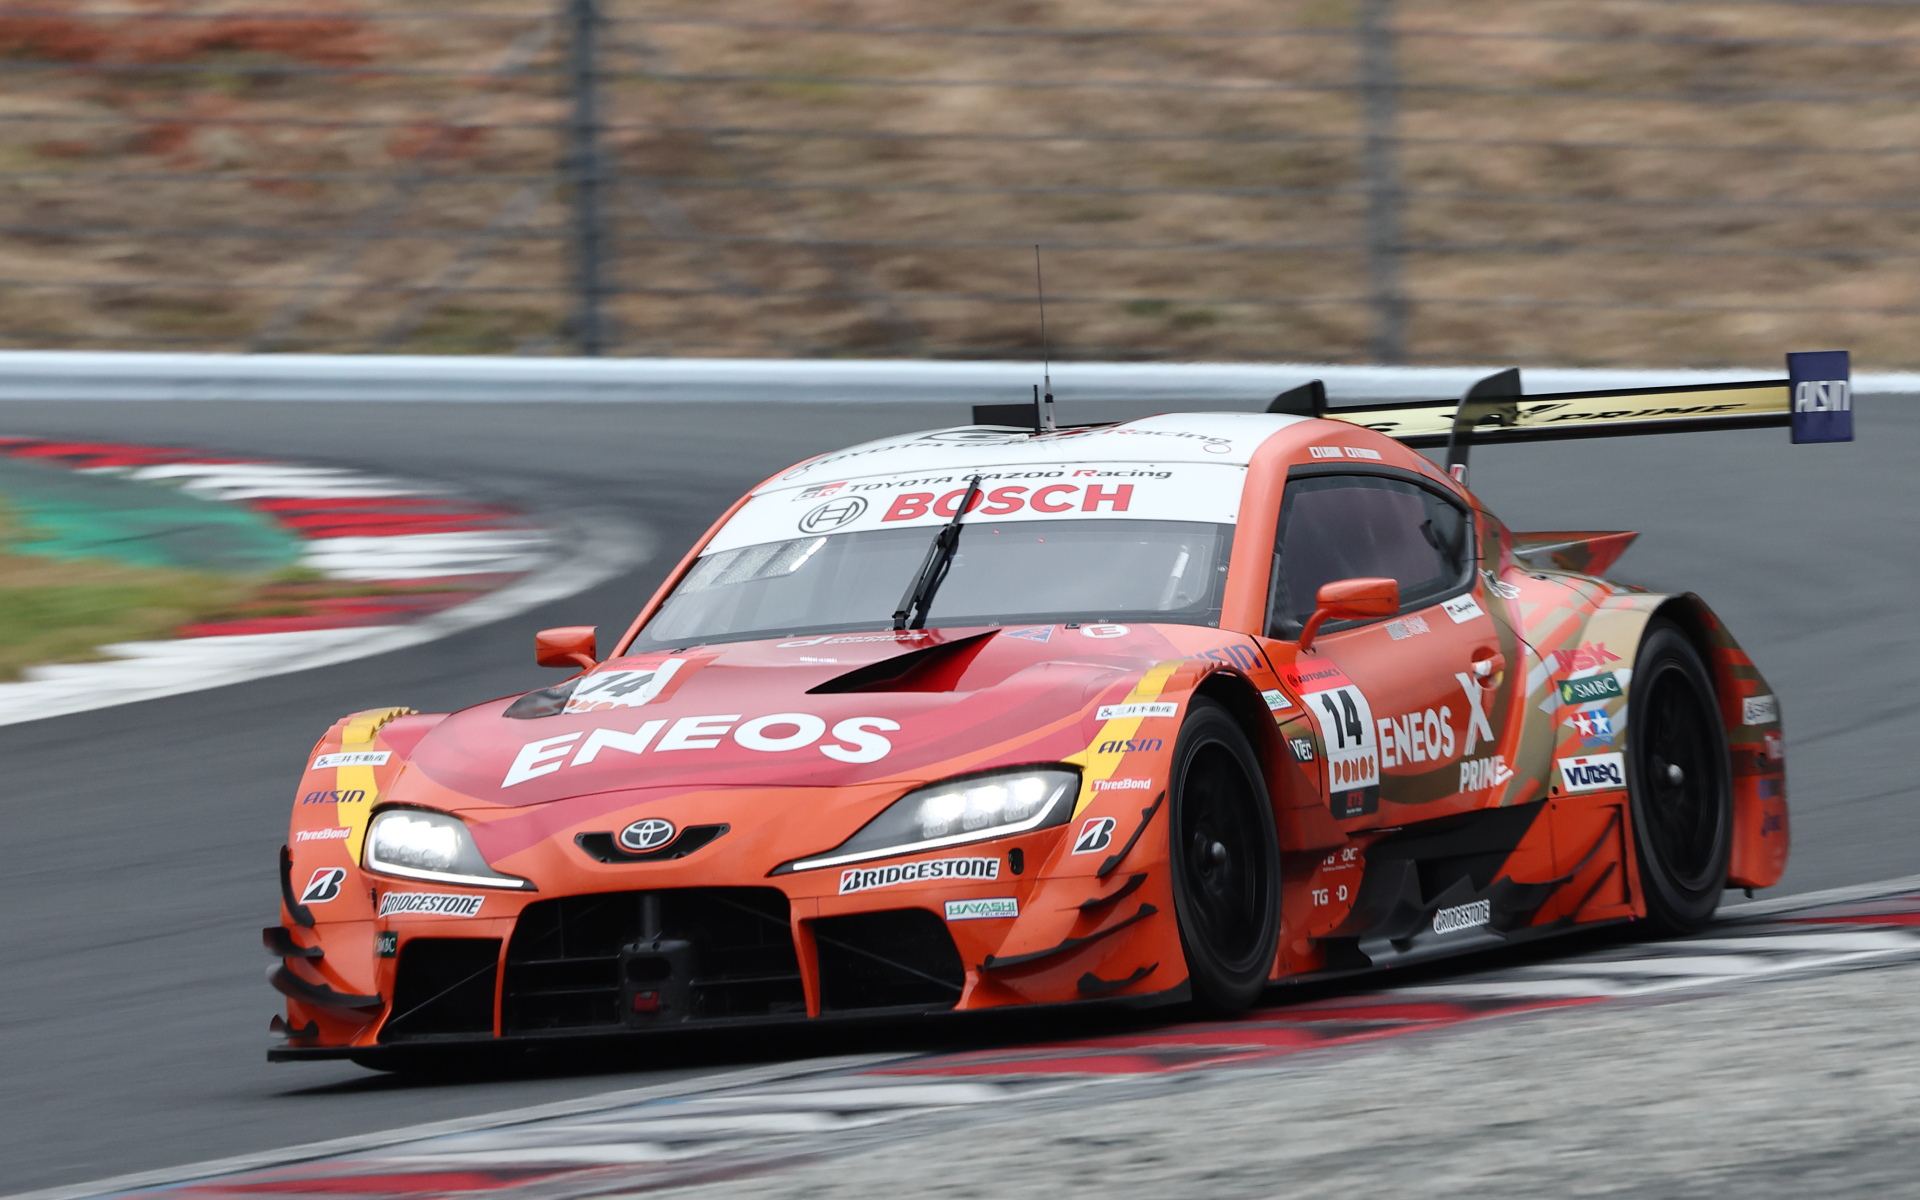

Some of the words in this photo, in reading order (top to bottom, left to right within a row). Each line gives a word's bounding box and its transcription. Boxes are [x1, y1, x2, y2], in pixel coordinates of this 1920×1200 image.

[1796, 380, 1849, 413] AISIN
[1546, 403, 1747, 422] PRIME
[1101, 428, 1233, 444] Racing
[849, 476, 952, 492] TOYOTA
[961, 470, 1065, 482] GAZOO
[1072, 469, 1173, 480] Racing
[881, 484, 1135, 523] BOSCH
[1552, 642, 1622, 673] NSK
[577, 671, 656, 697] 14
[1297, 668, 1340, 684] AUTOBACS
[1573, 677, 1618, 698] SMBC
[1321, 689, 1363, 749] 14
[1377, 705, 1455, 769] ENEOS
[1455, 672, 1495, 756] X
[500, 712, 901, 789] ENEOS
[1098, 738, 1163, 754] AISIN
[1333, 754, 1376, 786] PONOS
[1094, 778, 1152, 791] ThreeBond
[303, 789, 365, 805] AISIN
[296, 827, 351, 843] ThreeBond
[841, 858, 999, 892] BRIDGESTONE
[380, 893, 484, 916] BRIDGESTONE
[948, 901, 1016, 915] HAYASHI
[1434, 900, 1490, 933] BRIDGESTONE
